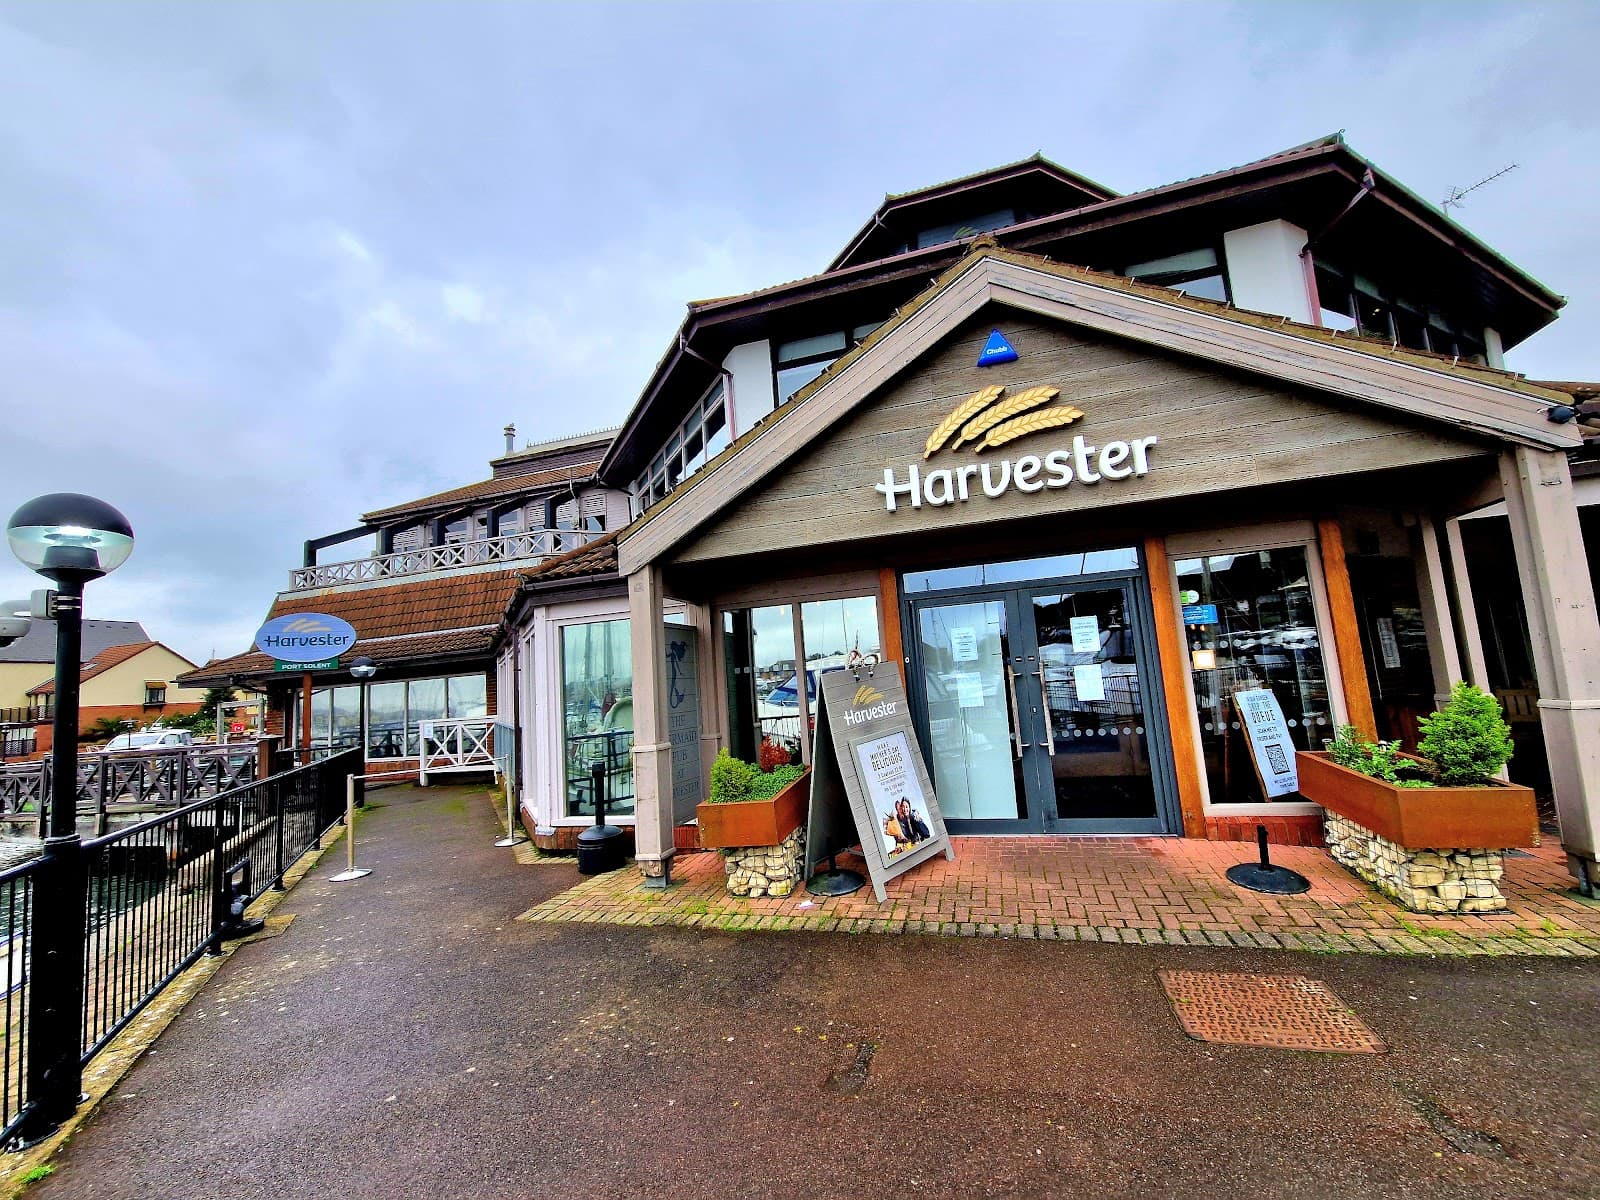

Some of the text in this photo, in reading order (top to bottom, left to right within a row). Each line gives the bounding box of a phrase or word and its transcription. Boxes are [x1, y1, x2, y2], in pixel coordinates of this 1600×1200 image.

[986, 346, 1008, 355] Chubb
[875, 435, 1157, 512] Harvester
[264, 634, 349, 647] Harvester
[844, 701, 897, 726] Harvester
[1251, 709, 1276, 723] QUEUE
[670, 731, 697, 745] RMAID
[871, 752, 903, 771] DELICIOUS
